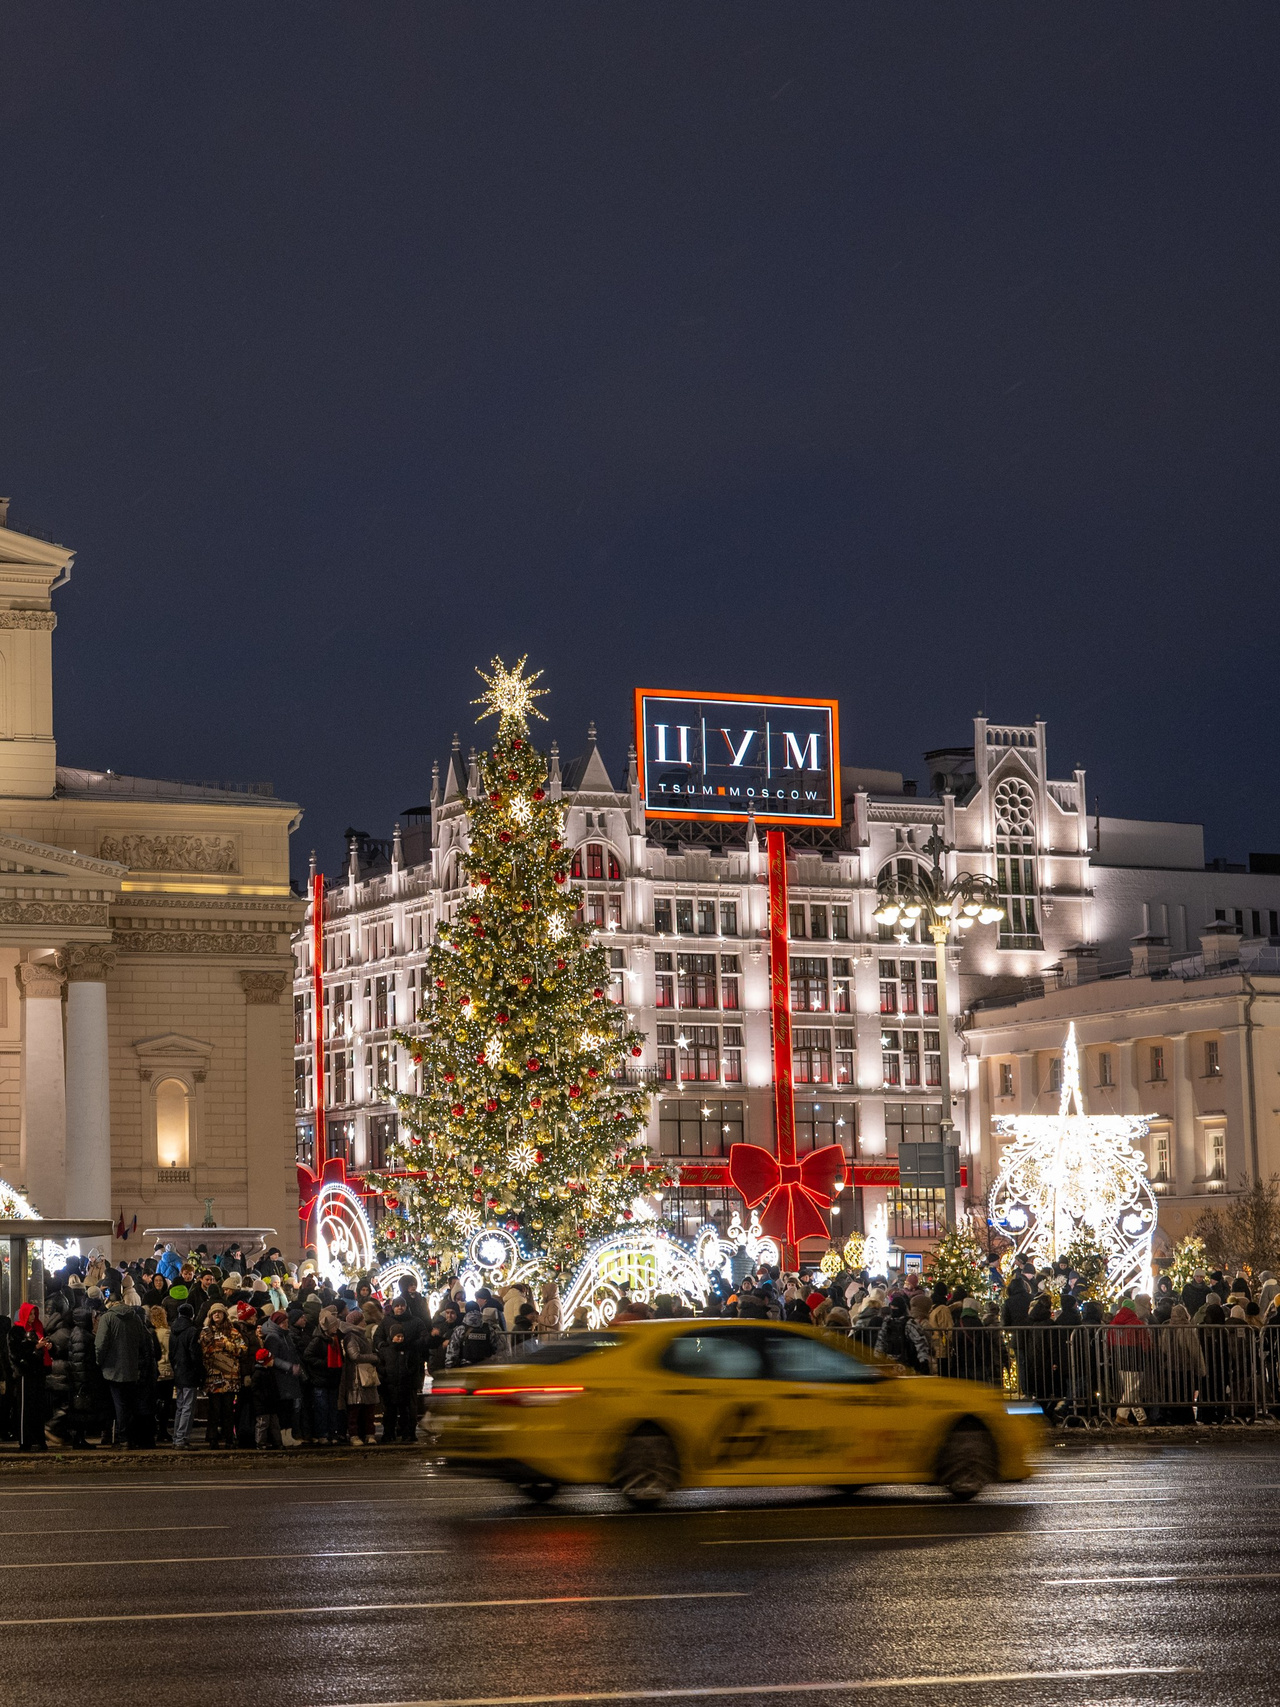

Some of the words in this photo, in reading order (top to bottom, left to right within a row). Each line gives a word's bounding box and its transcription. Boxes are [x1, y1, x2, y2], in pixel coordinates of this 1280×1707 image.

[658, 783, 713, 795] TSUM
[729, 786, 818, 800] MOSCOW
[773, 961, 787, 987] Year
[774, 989, 785, 1014] New
[775, 1013, 788, 1046] Happy
[700, 1168, 723, 1183] Year
